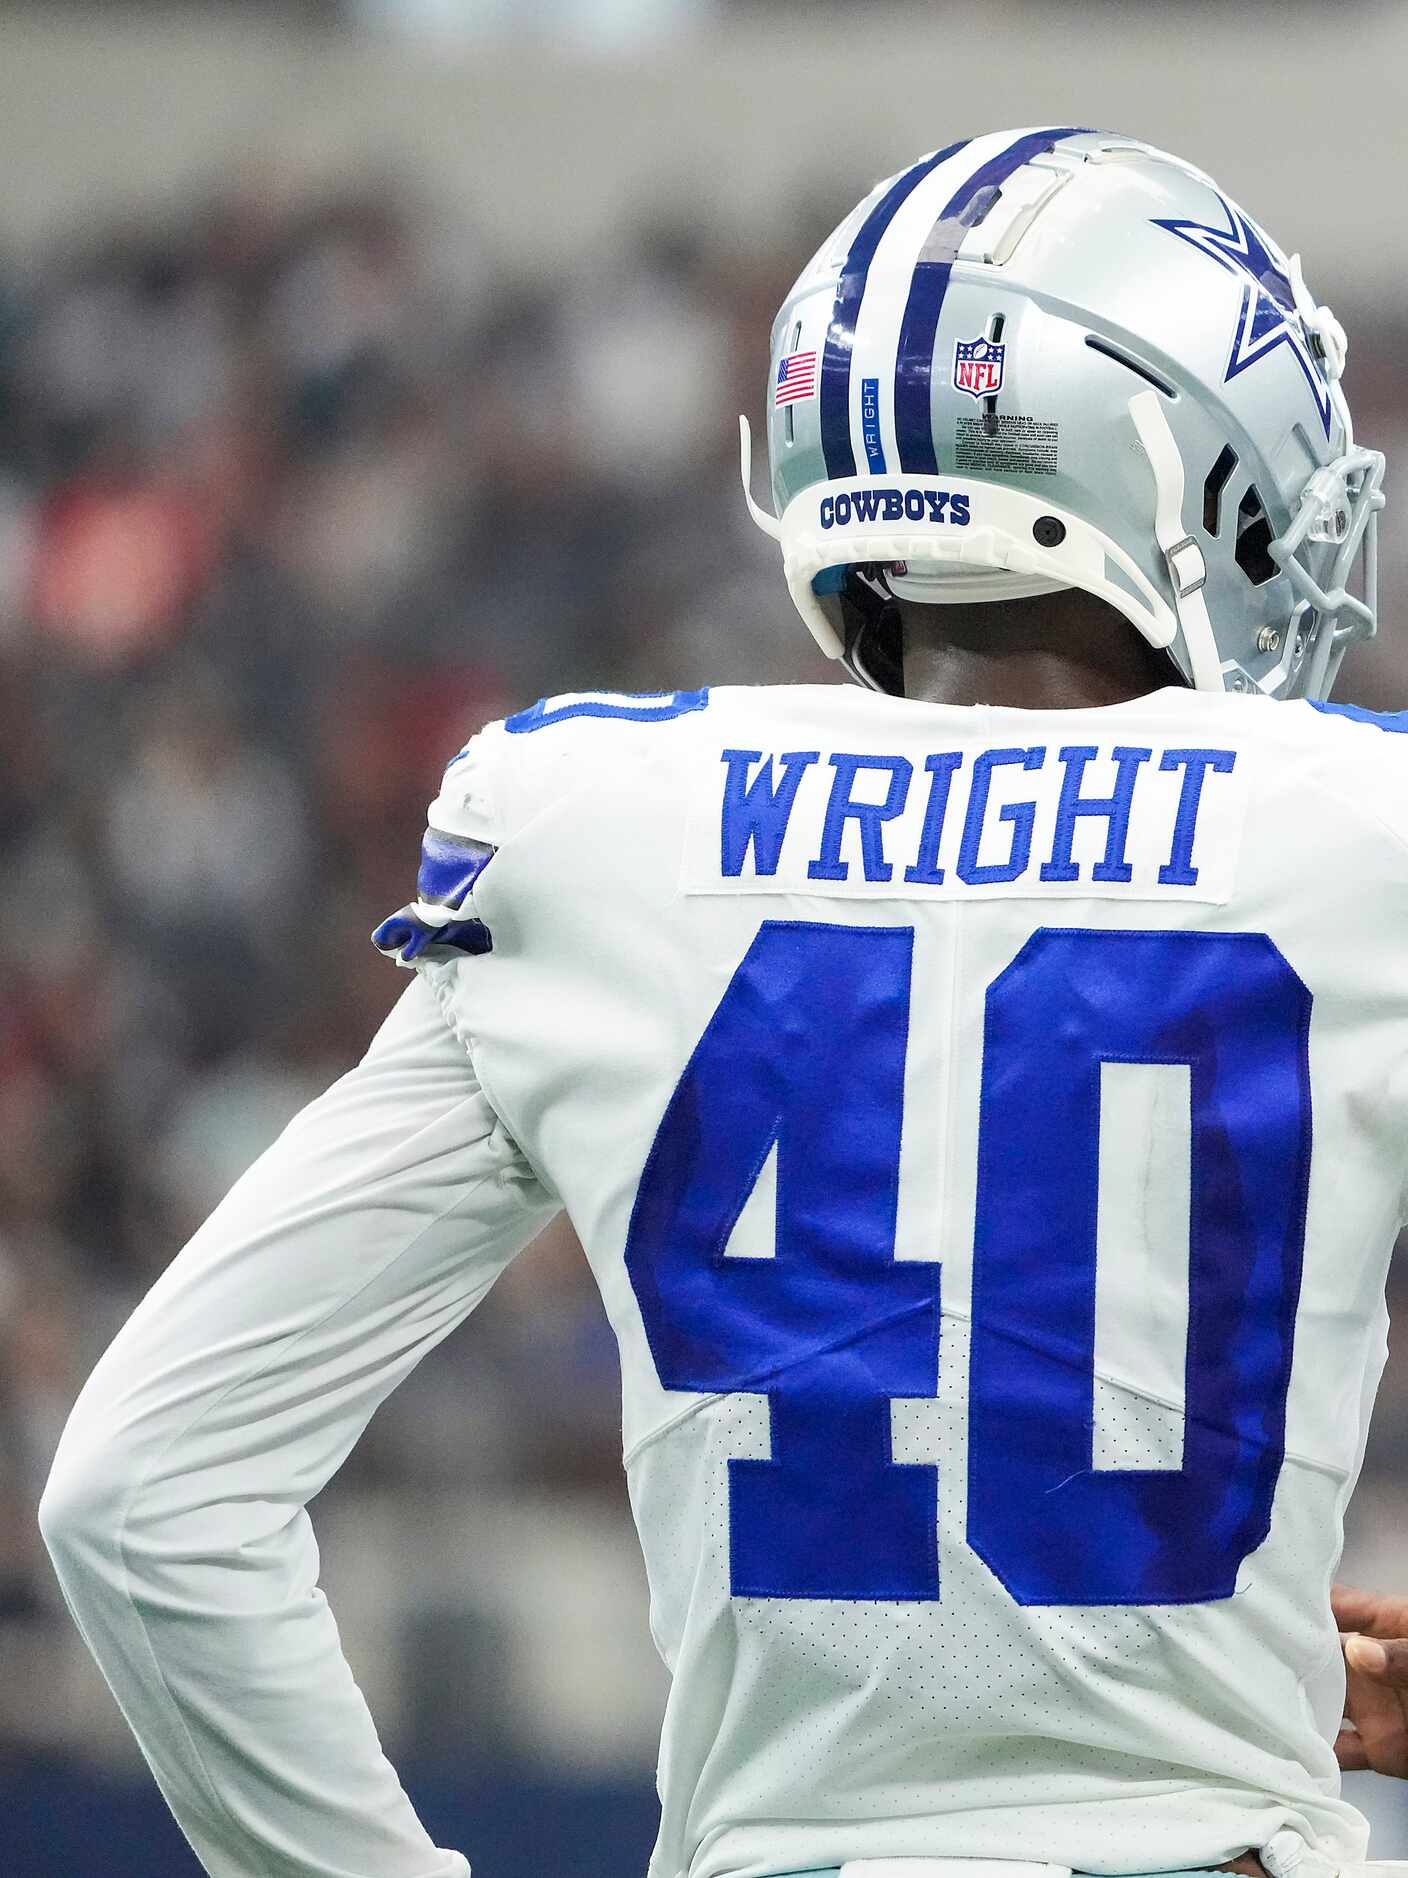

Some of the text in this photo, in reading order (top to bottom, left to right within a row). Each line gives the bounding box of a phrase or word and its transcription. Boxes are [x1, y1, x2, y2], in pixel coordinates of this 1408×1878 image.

[959, 362, 998, 392] NFL
[864, 382, 879, 458] WRIGHT
[820, 491, 971, 529] COWBOYS
[720, 746, 1237, 886] WRIGHT
[624, 919, 1314, 1607] 40
